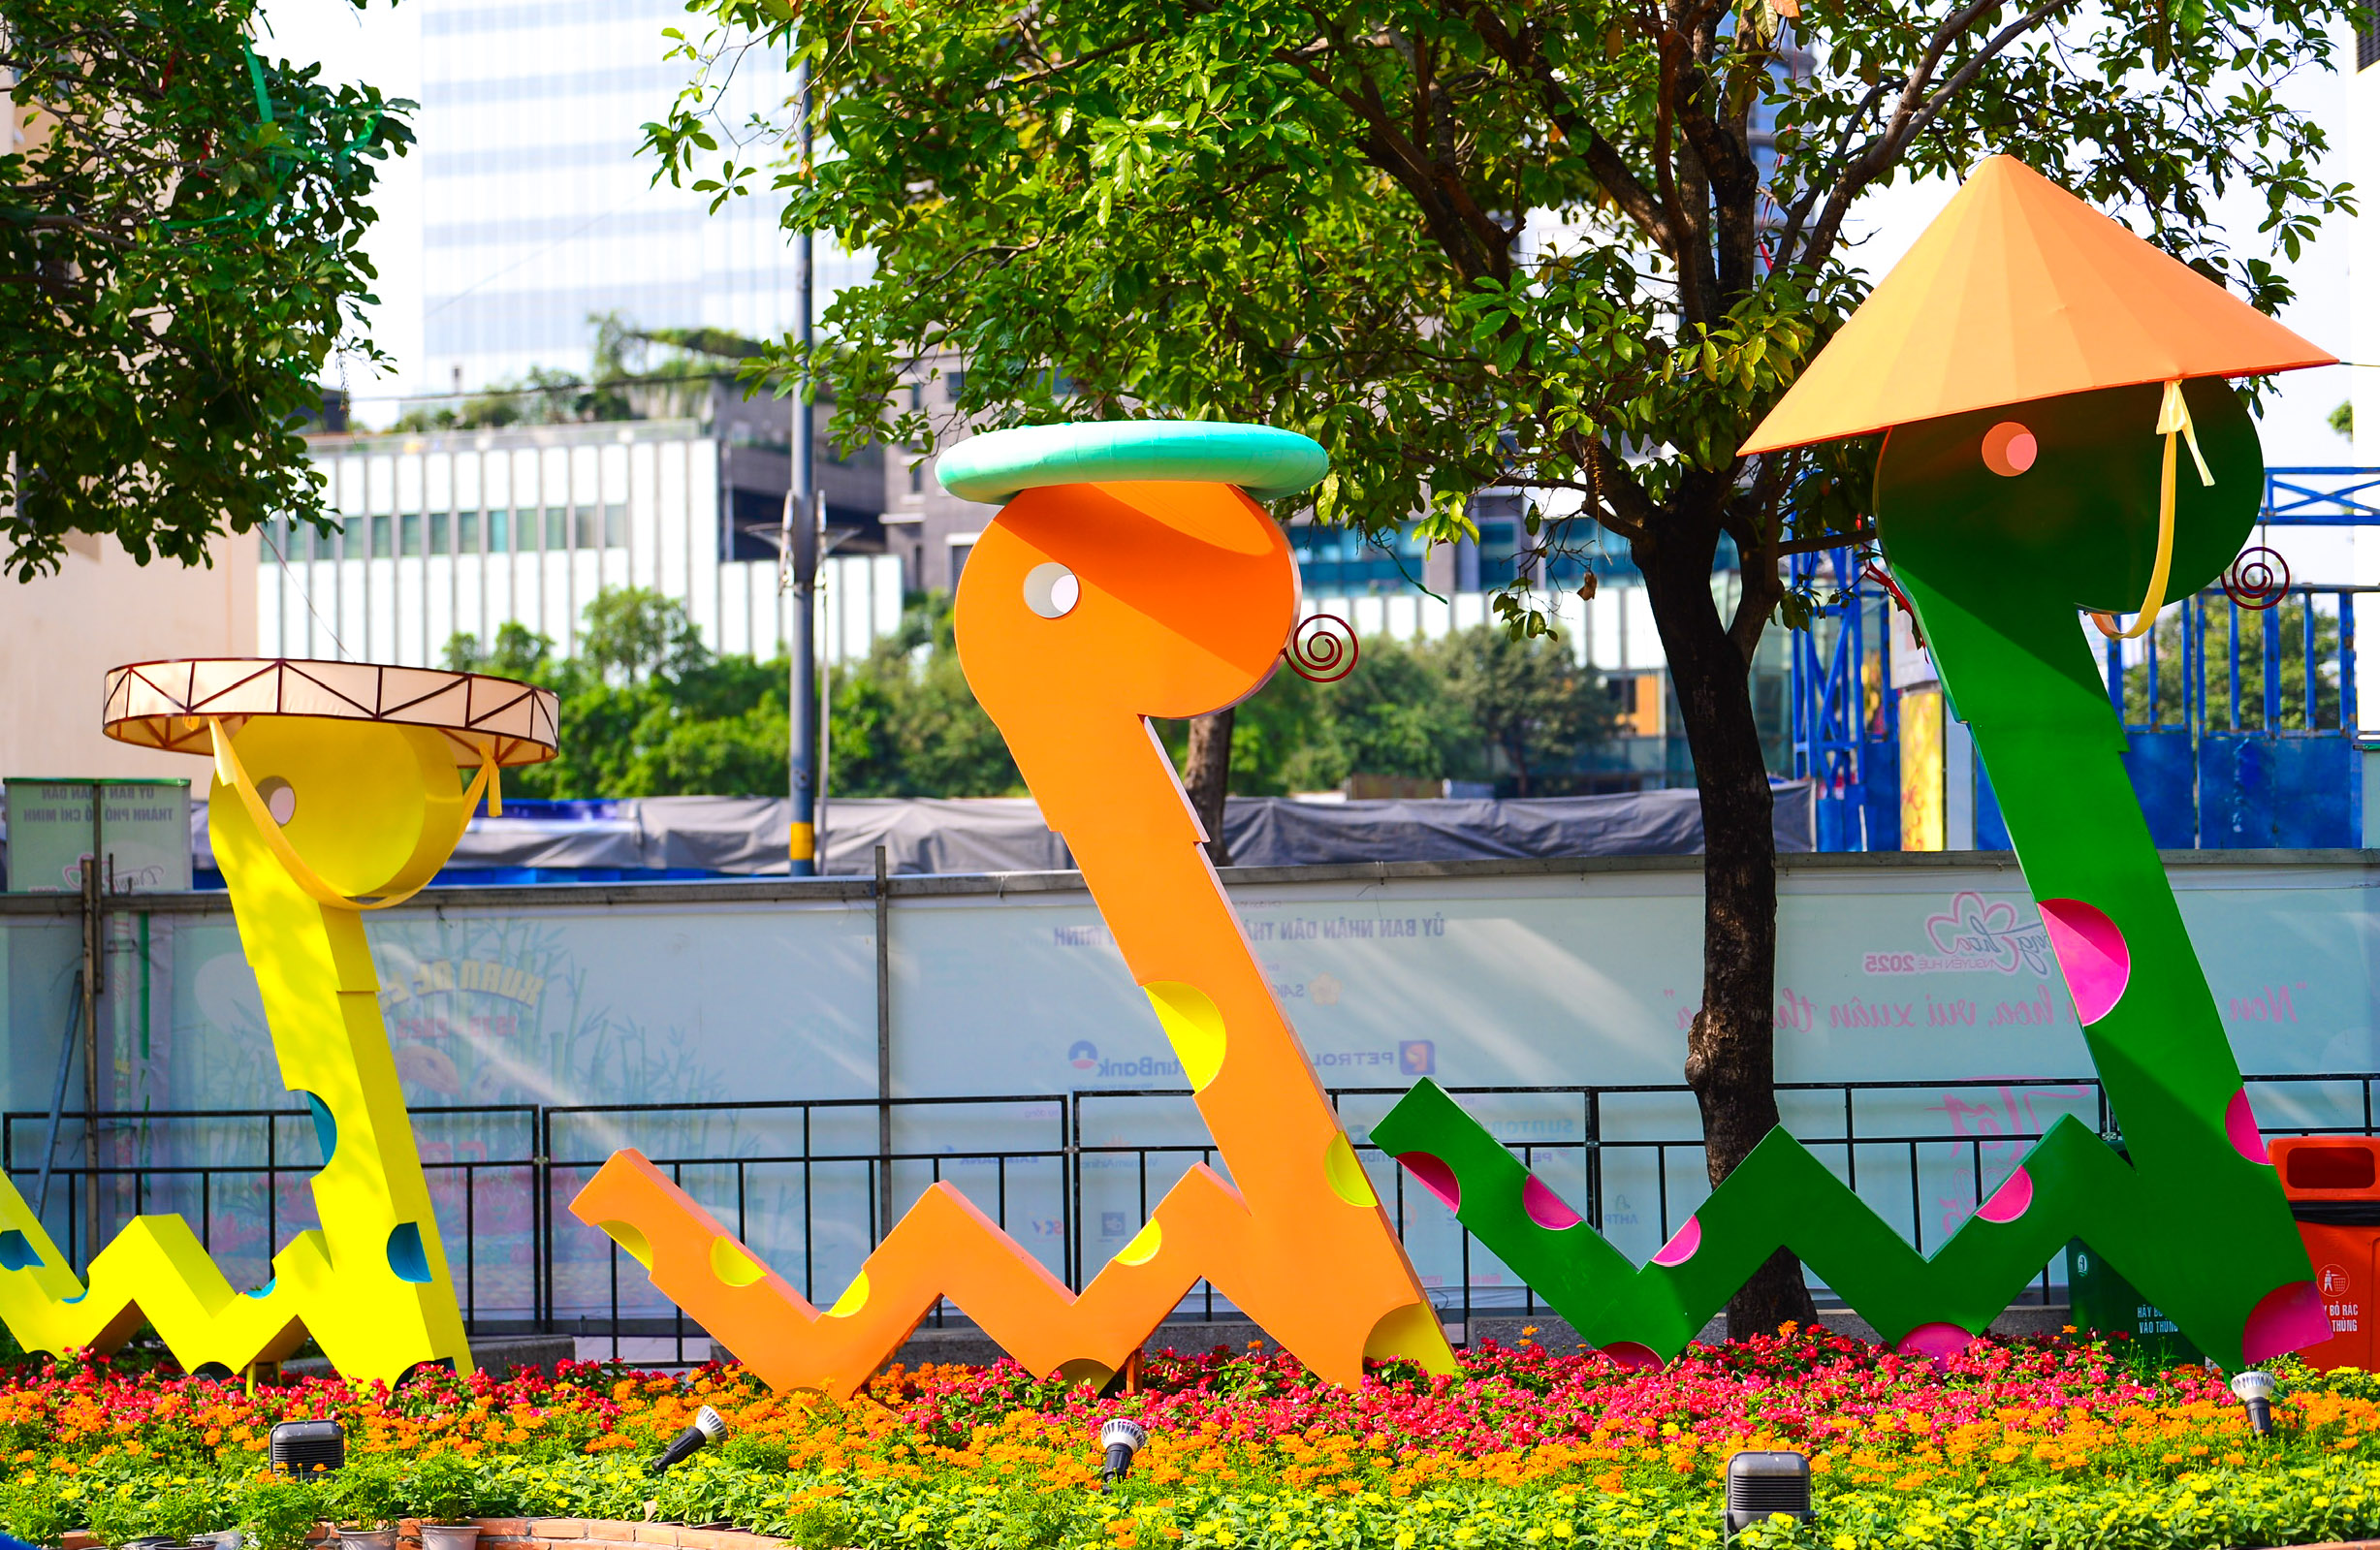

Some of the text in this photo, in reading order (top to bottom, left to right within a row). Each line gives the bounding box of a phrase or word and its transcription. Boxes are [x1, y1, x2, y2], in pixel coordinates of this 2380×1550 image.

[2329, 1300, 2340, 1316] BỎ
[2342, 1301, 2359, 1316] RÁC
[2139, 1318, 2154, 1335] VÀO
[2332, 1316, 2358, 1333] THÙNG
